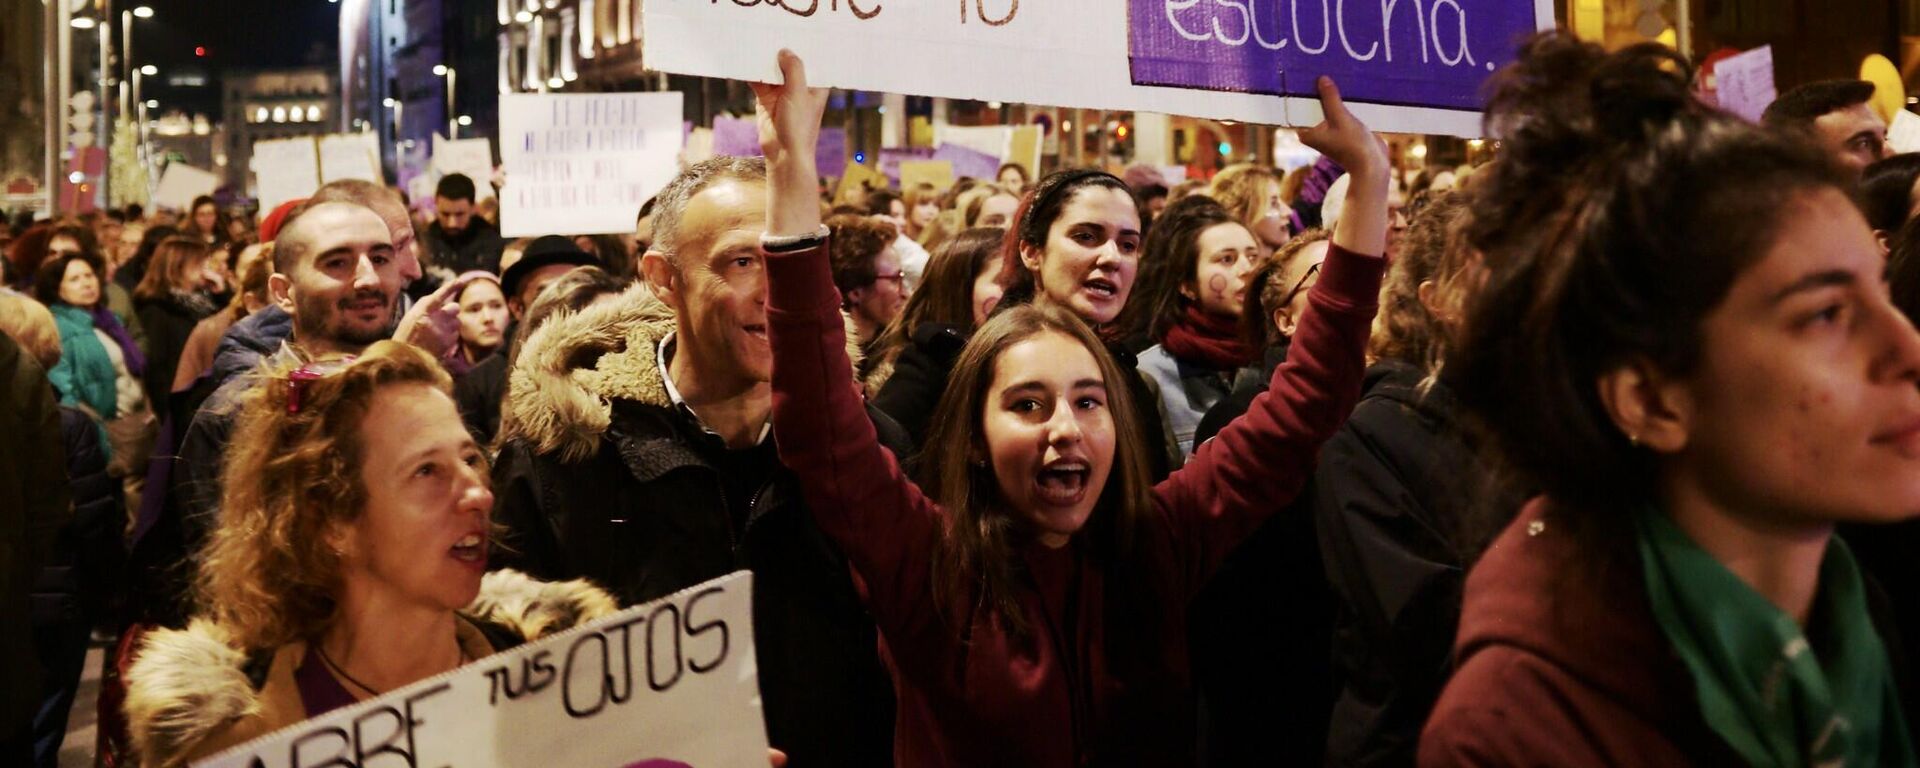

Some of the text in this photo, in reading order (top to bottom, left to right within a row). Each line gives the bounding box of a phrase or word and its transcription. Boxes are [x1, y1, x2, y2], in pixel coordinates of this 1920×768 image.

[248, 587, 729, 768] BRE TUS OJOS
